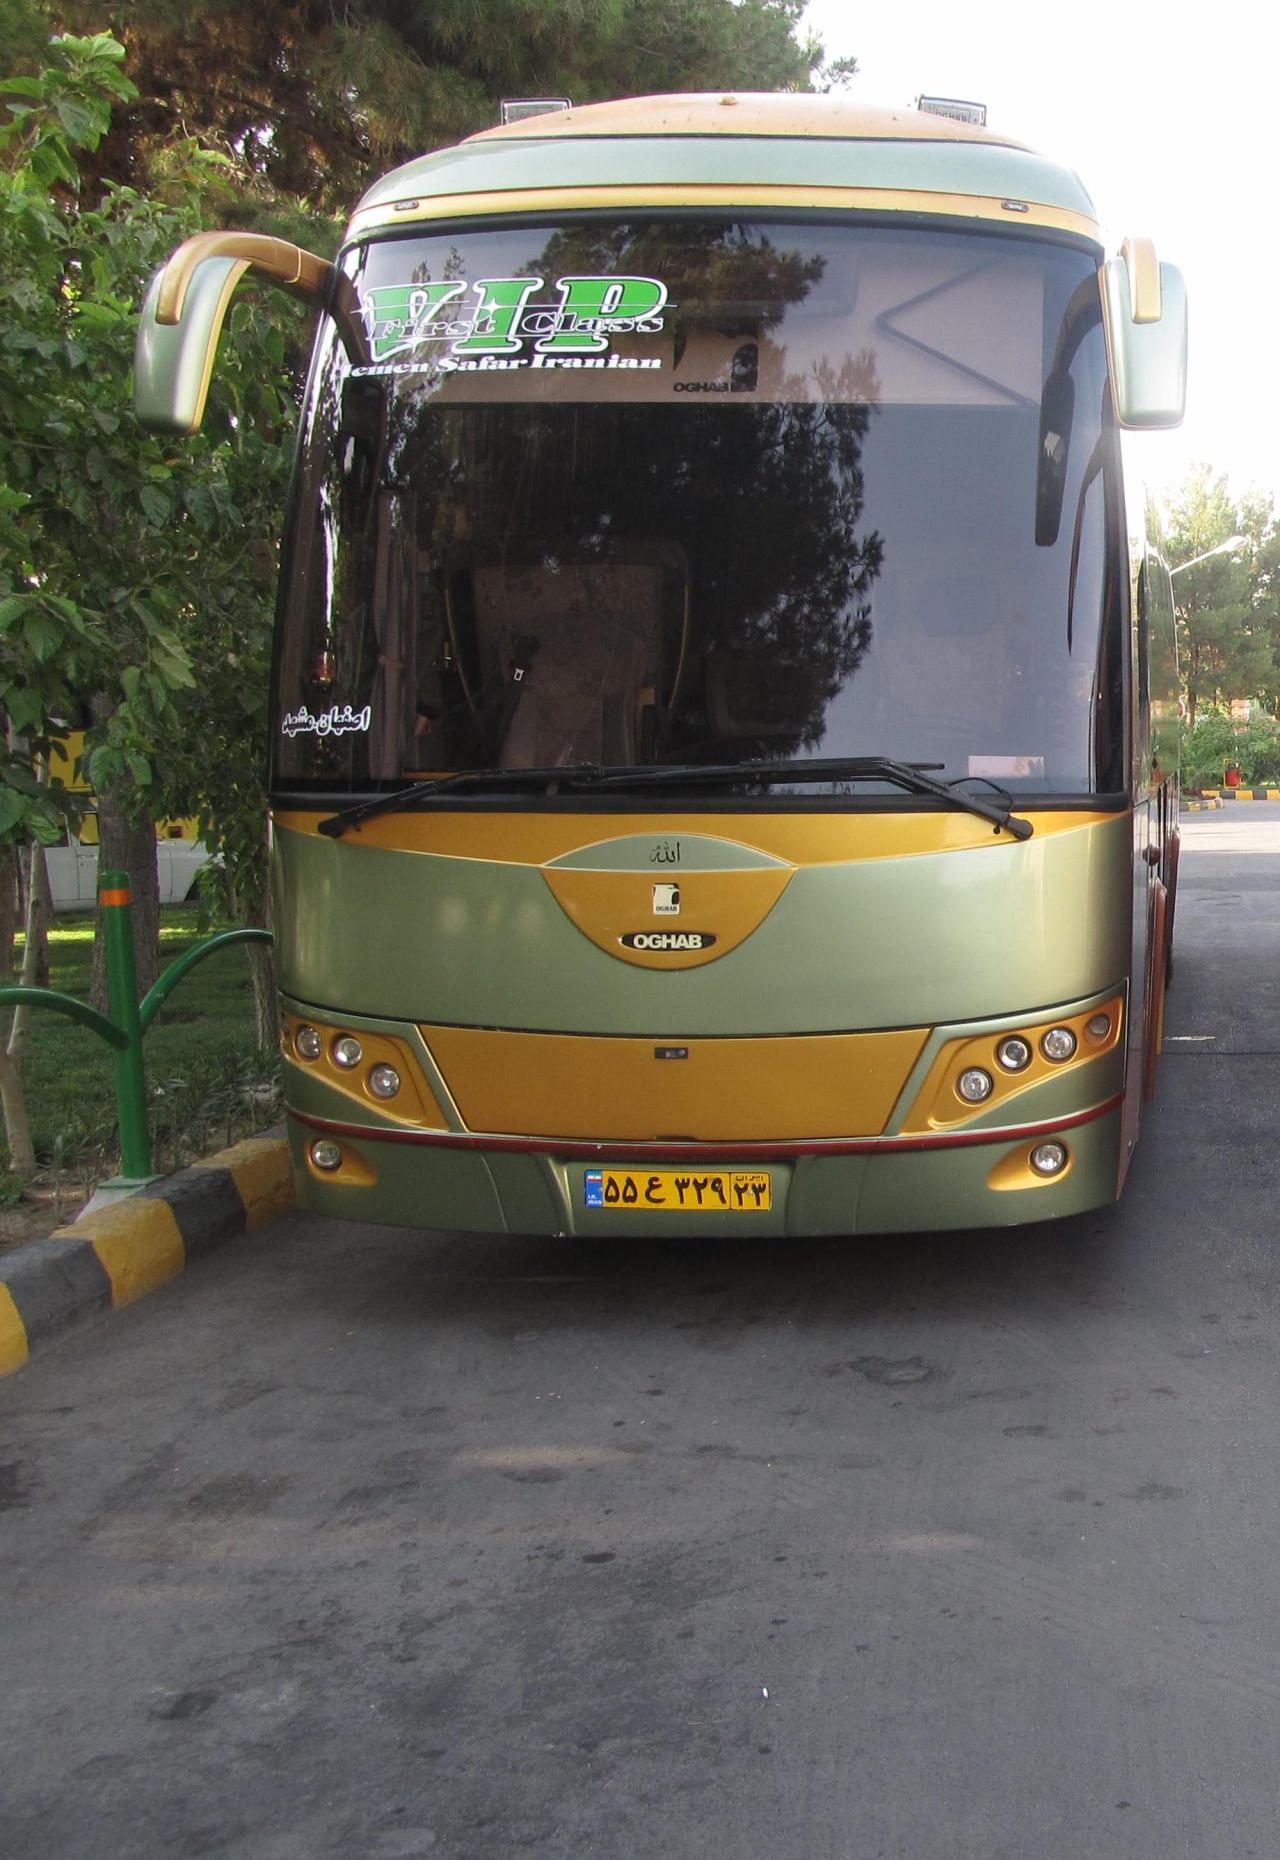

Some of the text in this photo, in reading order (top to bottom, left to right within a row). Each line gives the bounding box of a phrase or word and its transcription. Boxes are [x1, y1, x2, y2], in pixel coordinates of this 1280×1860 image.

[365, 276, 668, 362] VIP
[370, 312, 664, 339] First Class
[435, 355, 529, 373] Safar
[527, 352, 663, 370] Iranian
[633, 933, 704, 949] OGHAB
